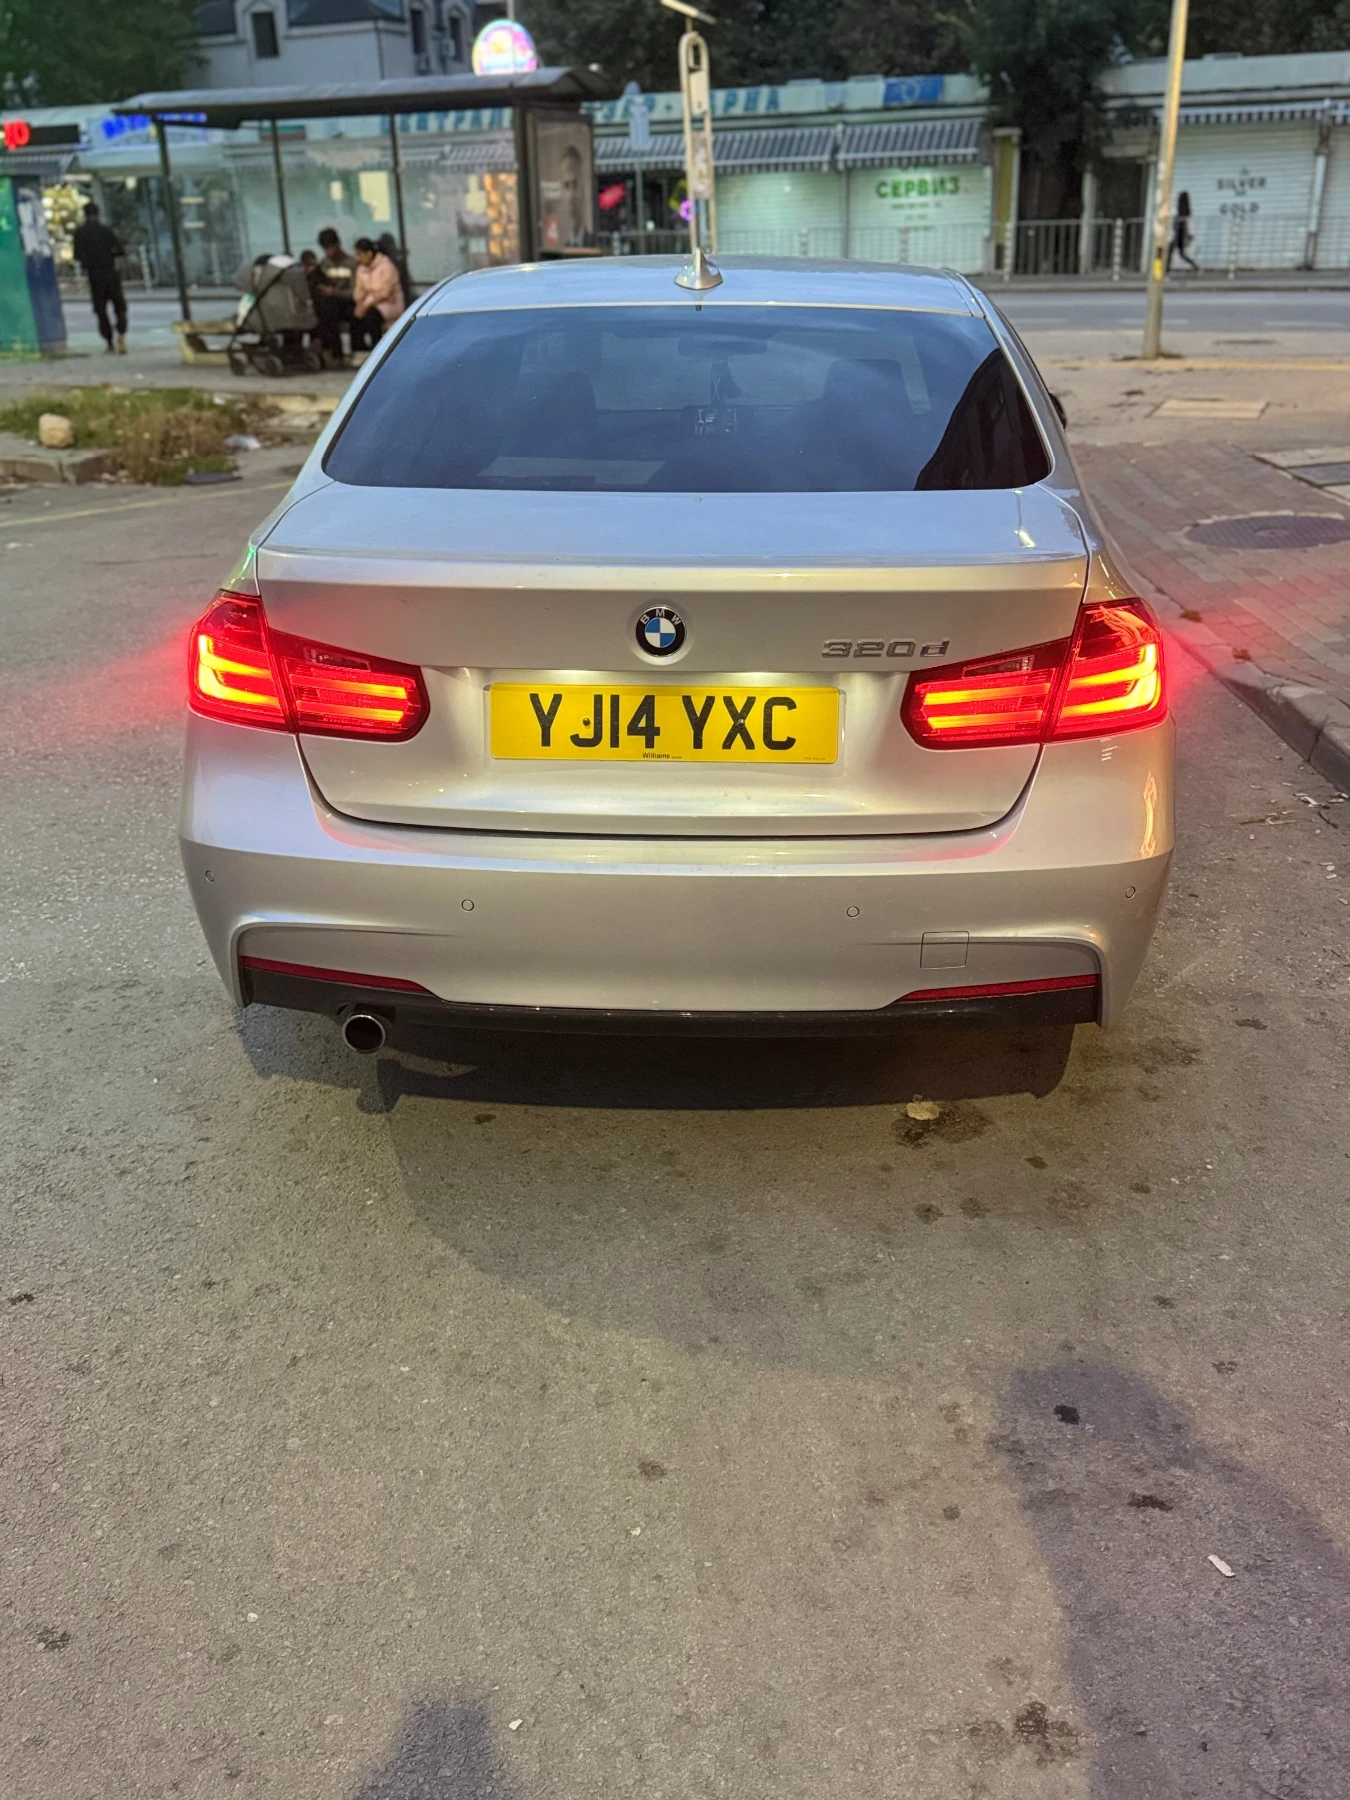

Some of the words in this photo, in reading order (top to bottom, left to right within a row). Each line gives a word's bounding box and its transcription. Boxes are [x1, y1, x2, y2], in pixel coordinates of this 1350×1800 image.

[876, 176, 960, 198] СЕРВИЗ
[640, 609, 682, 625] BMW
[821, 639, 950, 658] 320d
[529, 693, 660, 749] YJ14
[682, 695, 797, 751] YXC
[642, 752, 670, 760] Williams
